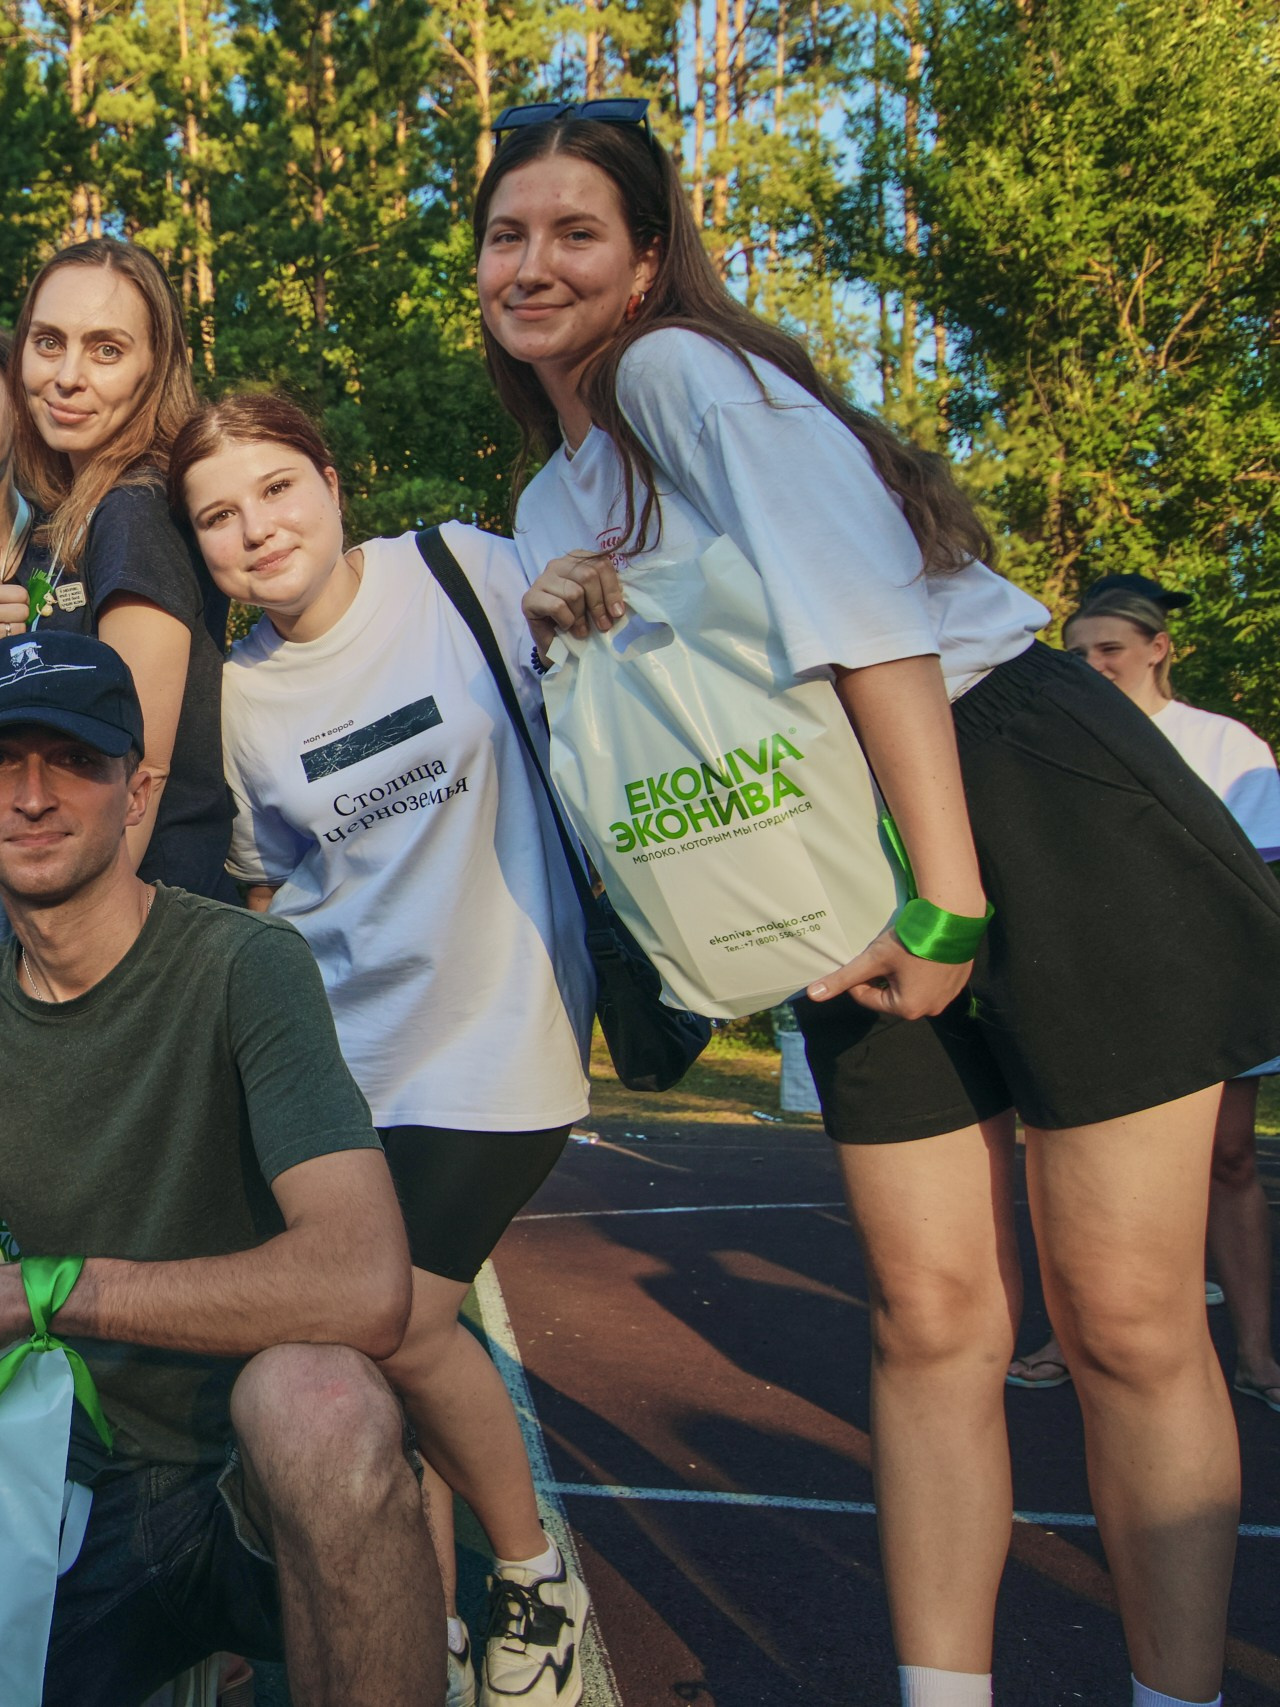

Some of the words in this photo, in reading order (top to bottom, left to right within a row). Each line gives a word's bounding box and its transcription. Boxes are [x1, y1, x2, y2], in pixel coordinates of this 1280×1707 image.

[327, 719, 355, 736] город
[323, 776, 469, 843] Черноземья
[333, 759, 448, 817] Столица
[609, 771, 806, 853] ЭКОНИВА
[632, 846, 680, 865] МОЛОКО,
[681, 831, 732, 852] КОТОРЫМ
[734, 826, 752, 837] МЫ
[754, 801, 813, 831] ГОРДИМСЯ
[709, 910, 827, 945] ekoniva-moloko.com
[755, 934, 779, 948] (800)
[779, 923, 821, 940] 550-57-00
